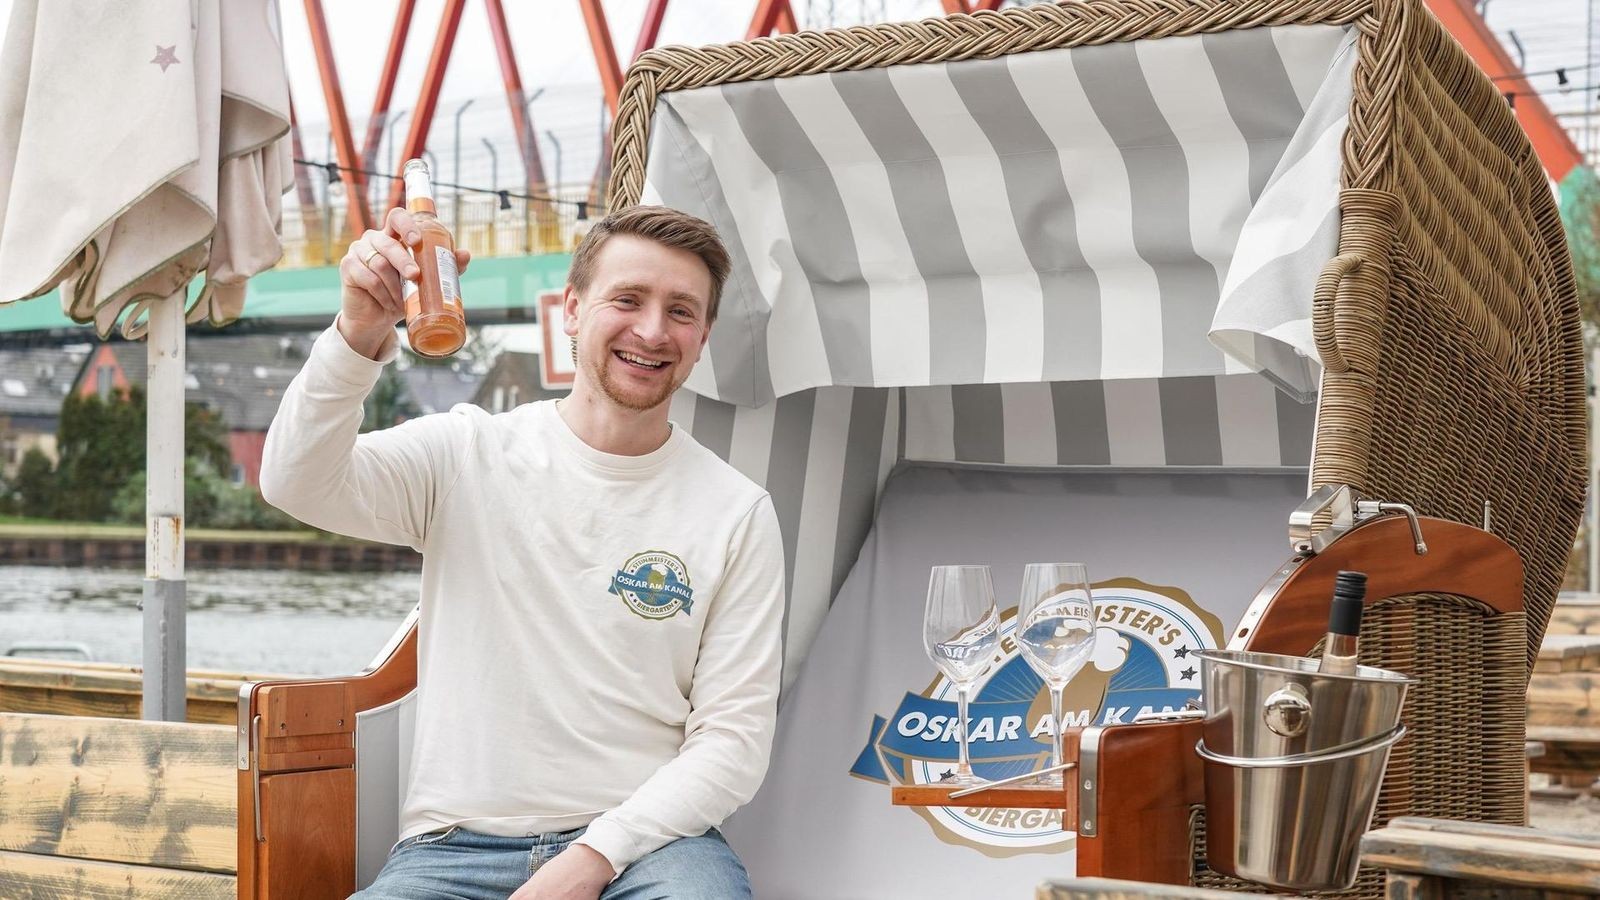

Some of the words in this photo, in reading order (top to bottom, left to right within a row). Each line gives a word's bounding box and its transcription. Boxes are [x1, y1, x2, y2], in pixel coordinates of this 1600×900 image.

[633, 556, 679, 571] STEINMEISTER'S
[617, 575, 648, 589] OSKAR
[664, 584, 690, 598] KANAL
[637, 602, 674, 613] BIERGARTEN
[897, 711, 1023, 743] OSKAR
[1029, 709, 1090, 738] AM
[964, 806, 1062, 829] BIERGA
